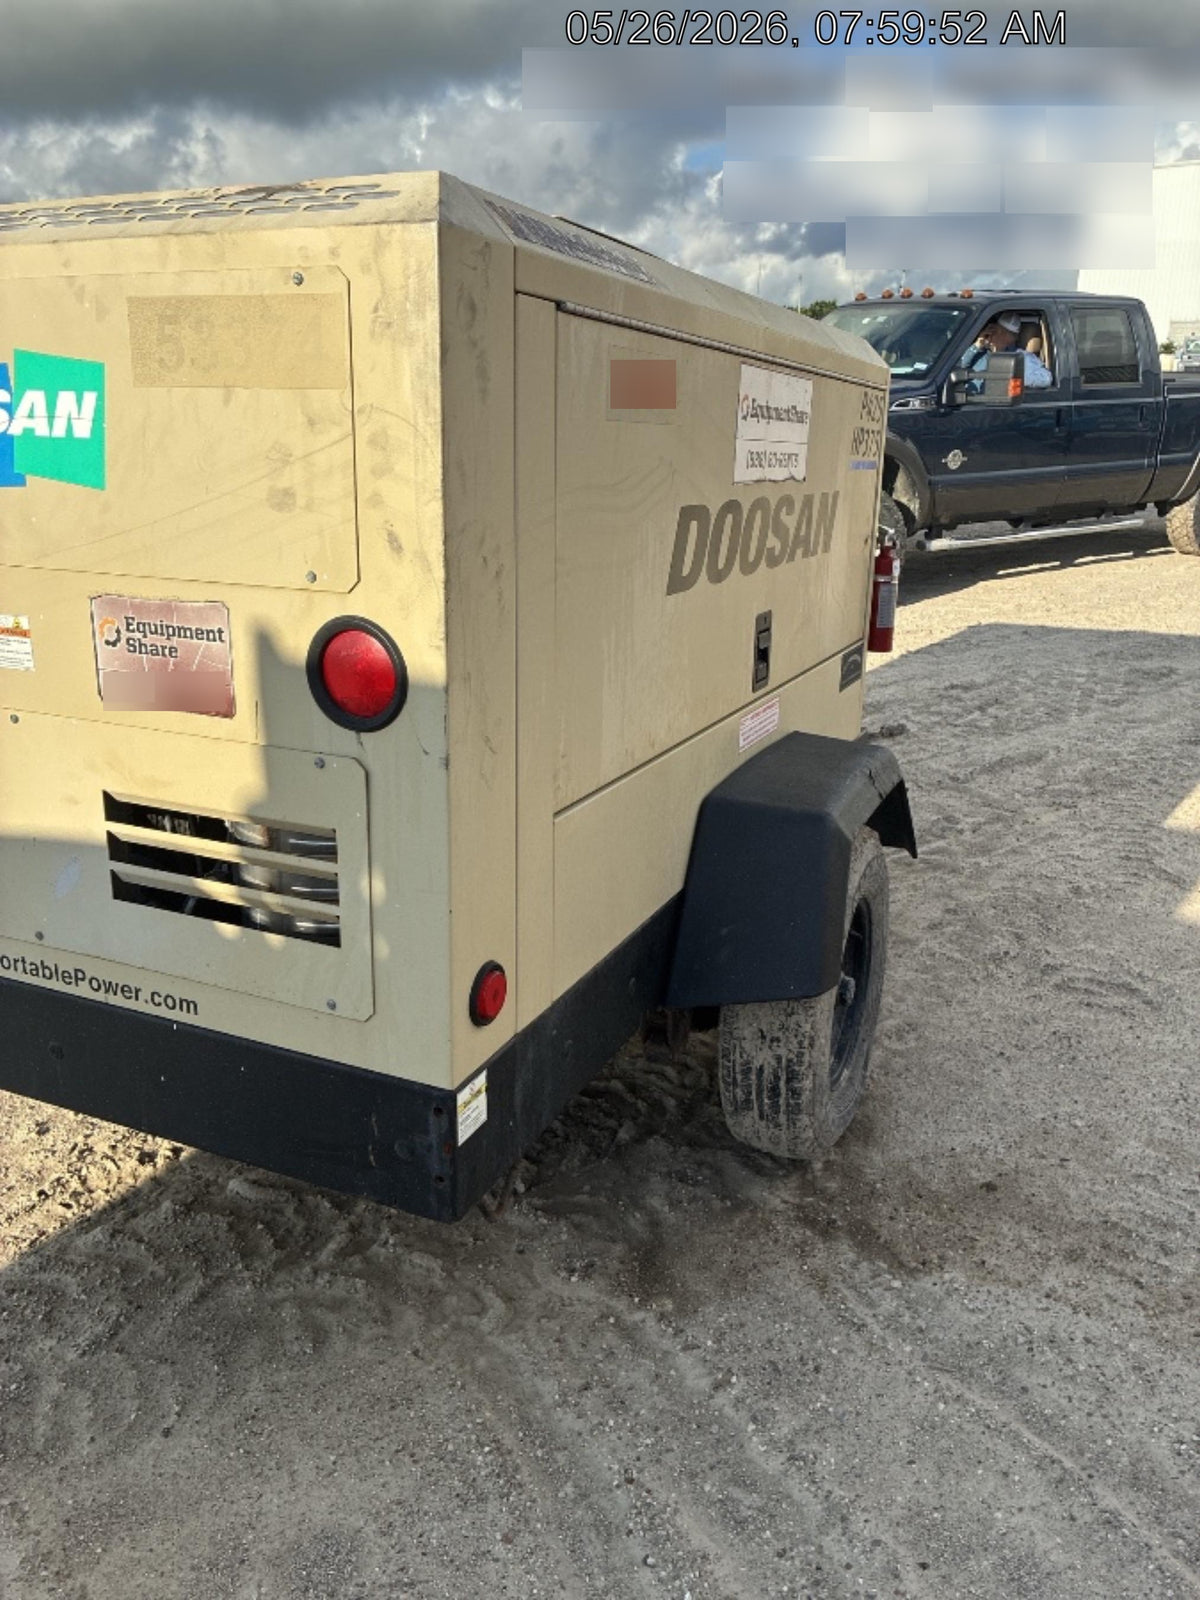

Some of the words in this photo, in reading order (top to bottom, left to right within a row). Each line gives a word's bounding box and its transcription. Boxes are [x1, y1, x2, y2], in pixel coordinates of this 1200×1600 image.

[666, 490, 840, 596] DOOSAN
[124, 616, 225, 643] Equipment
[126, 637, 179, 659] Share
